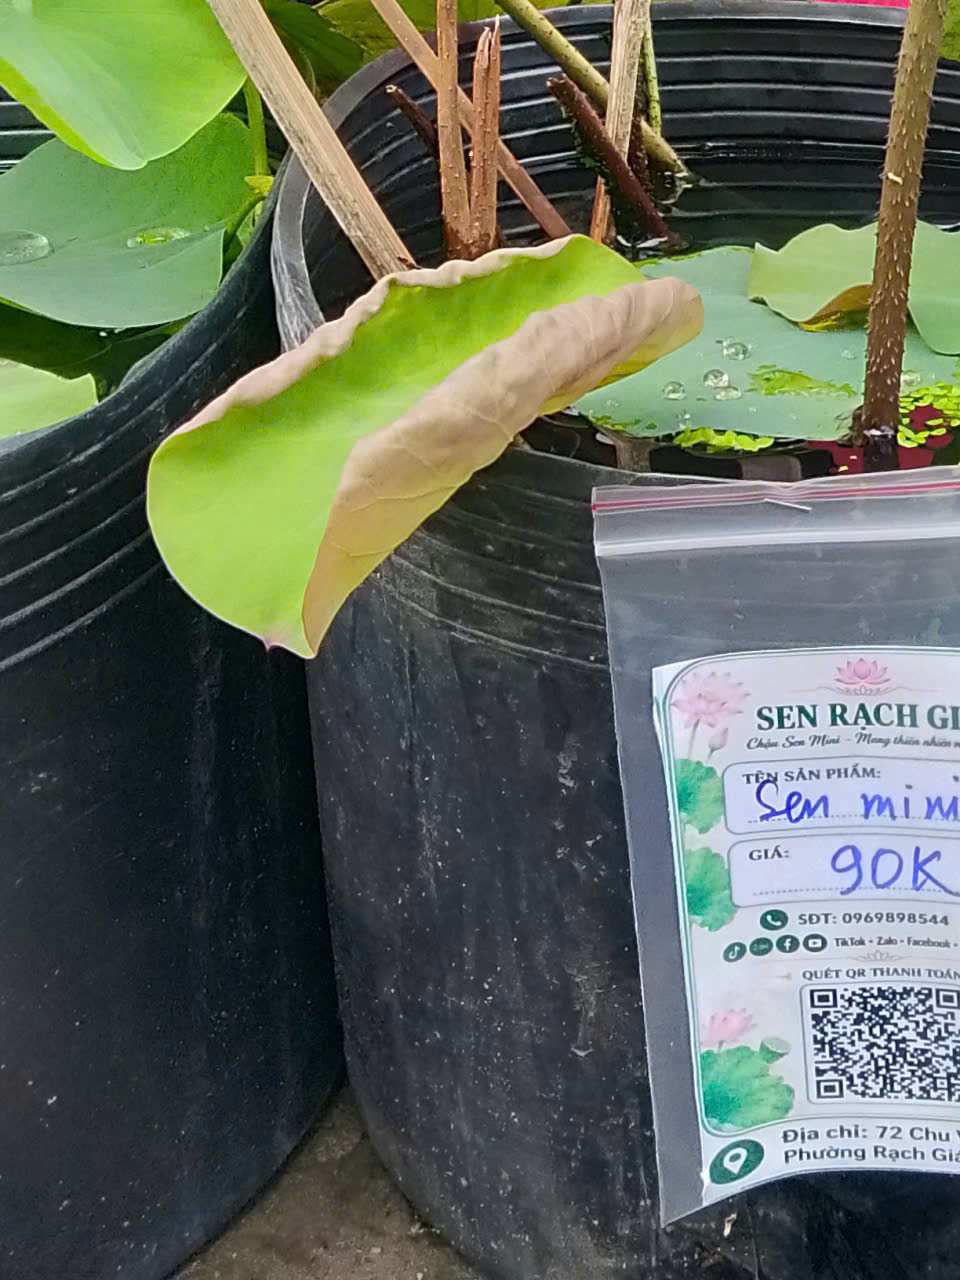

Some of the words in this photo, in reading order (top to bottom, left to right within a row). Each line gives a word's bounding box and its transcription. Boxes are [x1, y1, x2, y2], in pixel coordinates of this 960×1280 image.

[756, 703, 818, 731] SEN
[829, 702, 919, 732] RẠCH
[747, 736, 778, 750] Chậu
[782, 735, 805, 749] Sen
[808, 734, 841, 747] Mini
[854, 732, 890, 749] Mang
[893, 735, 920, 747] thiên
[922, 735, 951, 748] nhiên
[742, 769, 779, 785] TÊN
[784, 765, 821, 783] SẢN
[826, 762, 881, 781] PHẨM:
[755, 778, 830, 824] Sen
[861, 775, 960, 821] mini
[748, 845, 790, 862] GIÁ:
[798, 913, 837, 926] SĐT:
[842, 912, 950, 927] 0969898544
[834, 937, 866, 947] TikTok
[876, 936, 898, 947] Zalo
[907, 936, 950, 949] Facebook
[802, 967, 841, 981] QUÉT
[846, 968, 867, 981] QR
[871, 967, 922, 979] THANH
[781, 1127, 819, 1144] Địa
[825, 1124, 868, 1140] chỉ:
[876, 1124, 903, 1140] 72
[908, 1125, 951, 1143] Chu
[783, 1144, 866, 1165] Phường
[873, 1144, 926, 1164] Rạch
